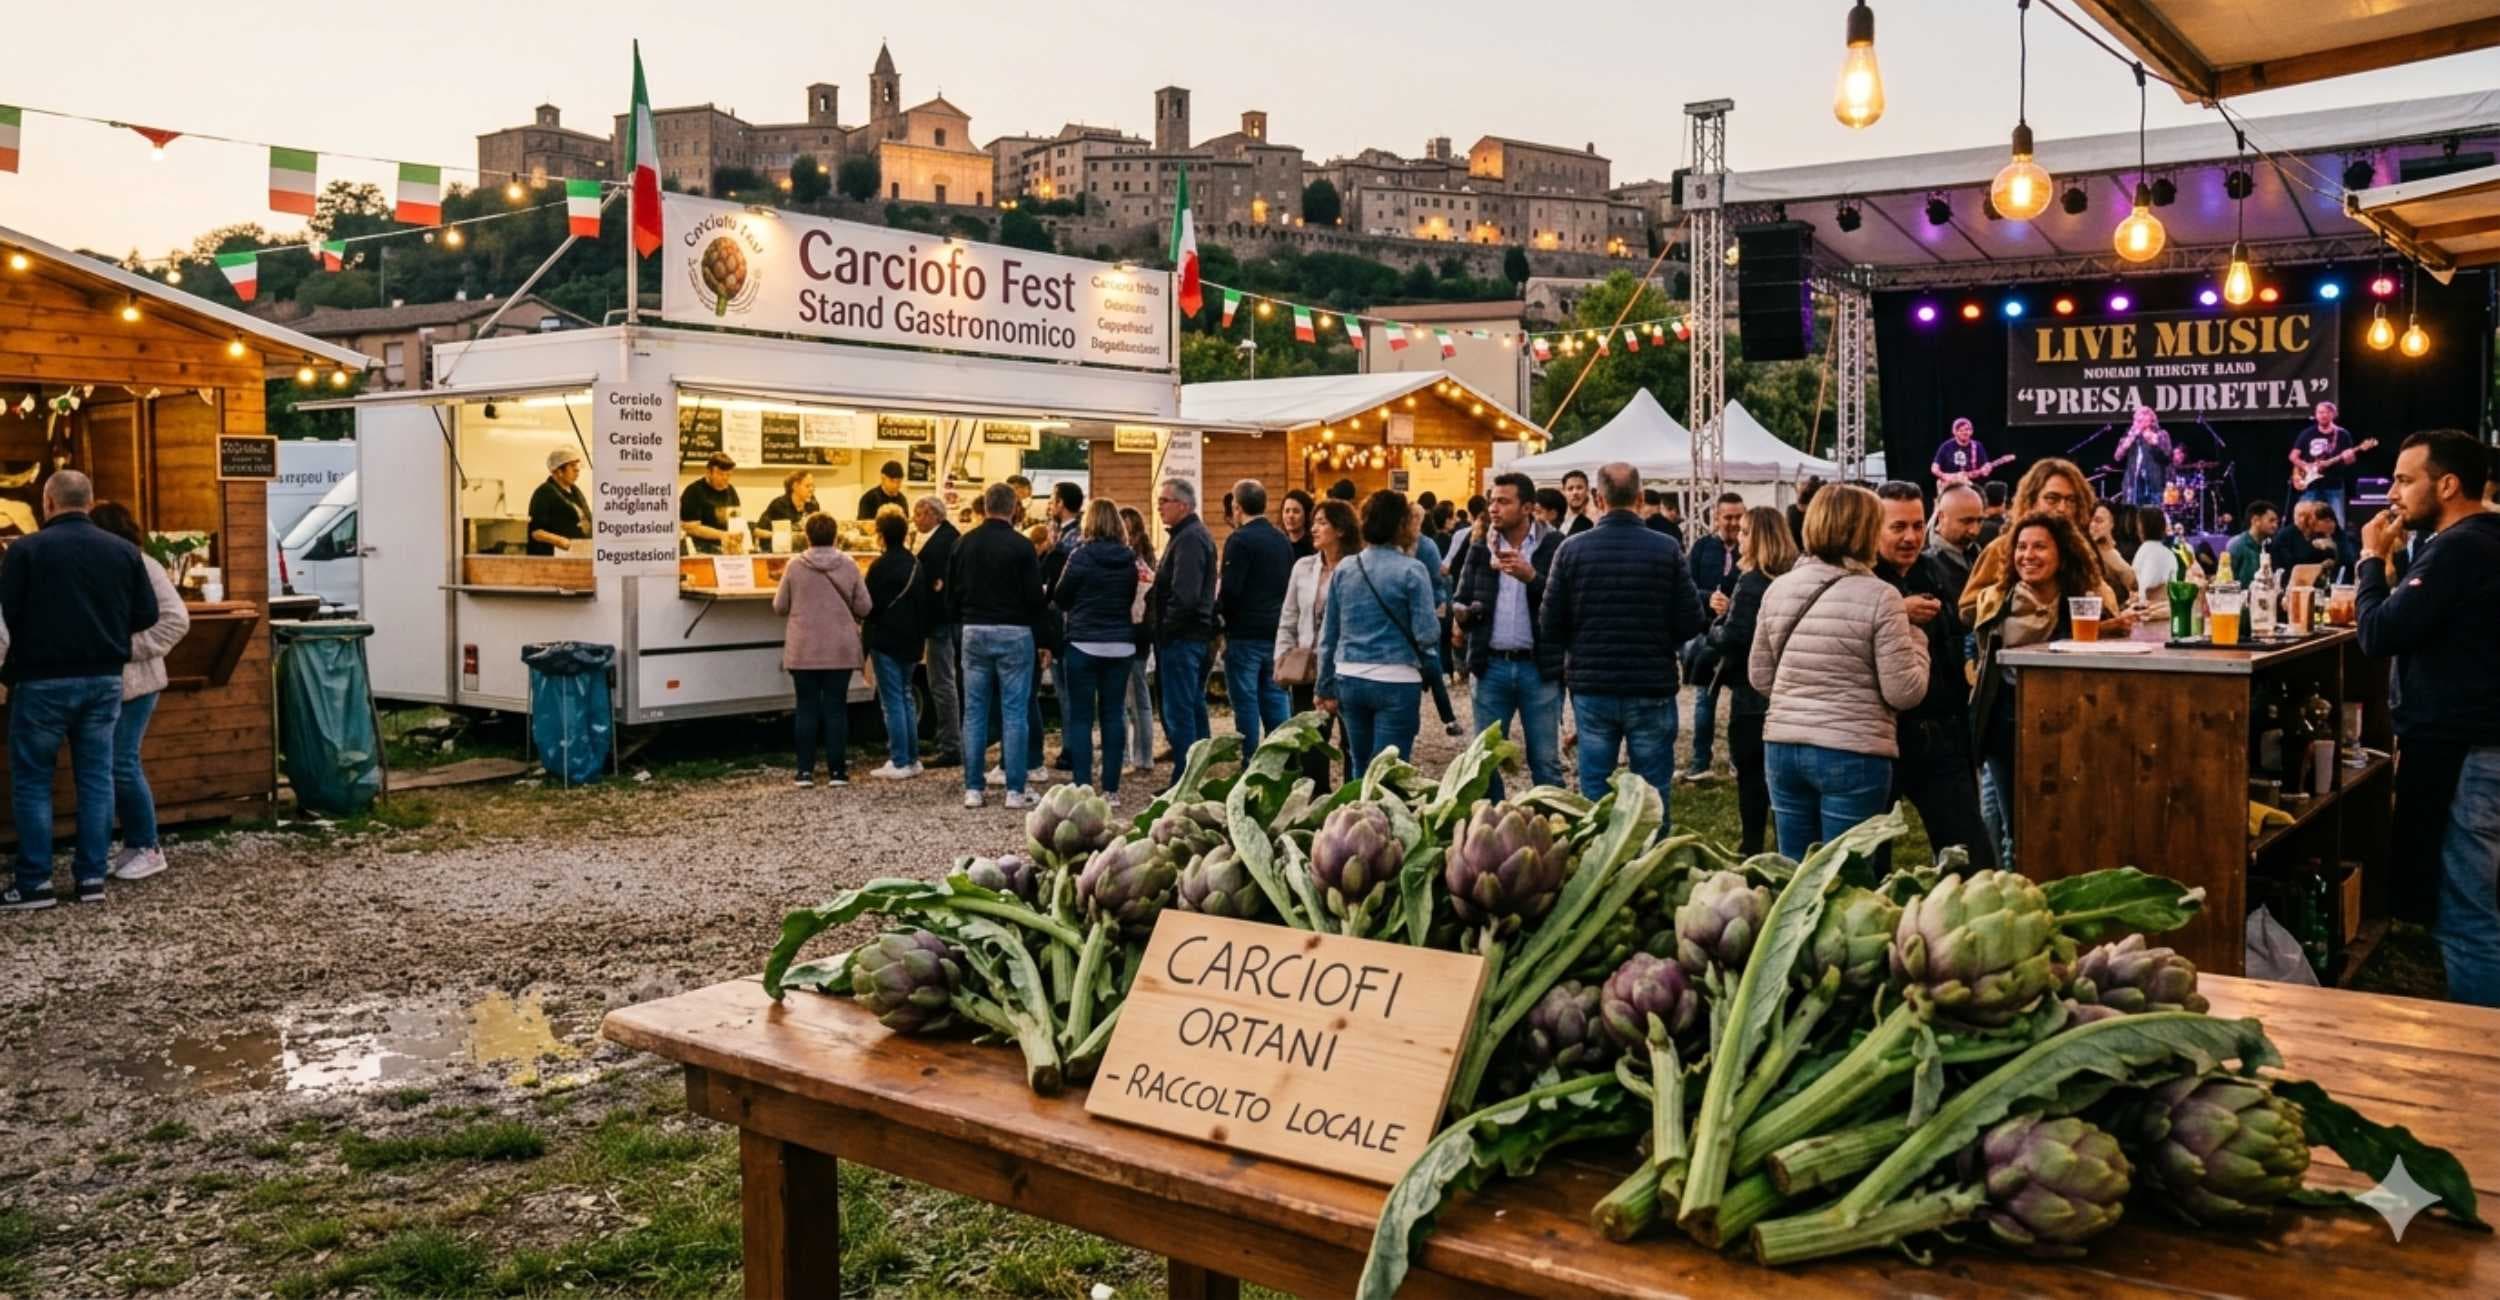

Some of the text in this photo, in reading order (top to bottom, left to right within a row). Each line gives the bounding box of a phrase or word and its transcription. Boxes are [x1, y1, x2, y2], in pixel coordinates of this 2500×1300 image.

[799, 229, 1076, 312] Carciofo Fest
[799, 289, 884, 330] Stand
[894, 300, 1076, 349] Gastronomico
[2036, 314, 2311, 363] LIVE MUSIC
[1167, 936, 1403, 1019] CARCIOFI
[1179, 1007, 1338, 1071] ORTANI
[1285, 1103, 1406, 1154] LOCALE
